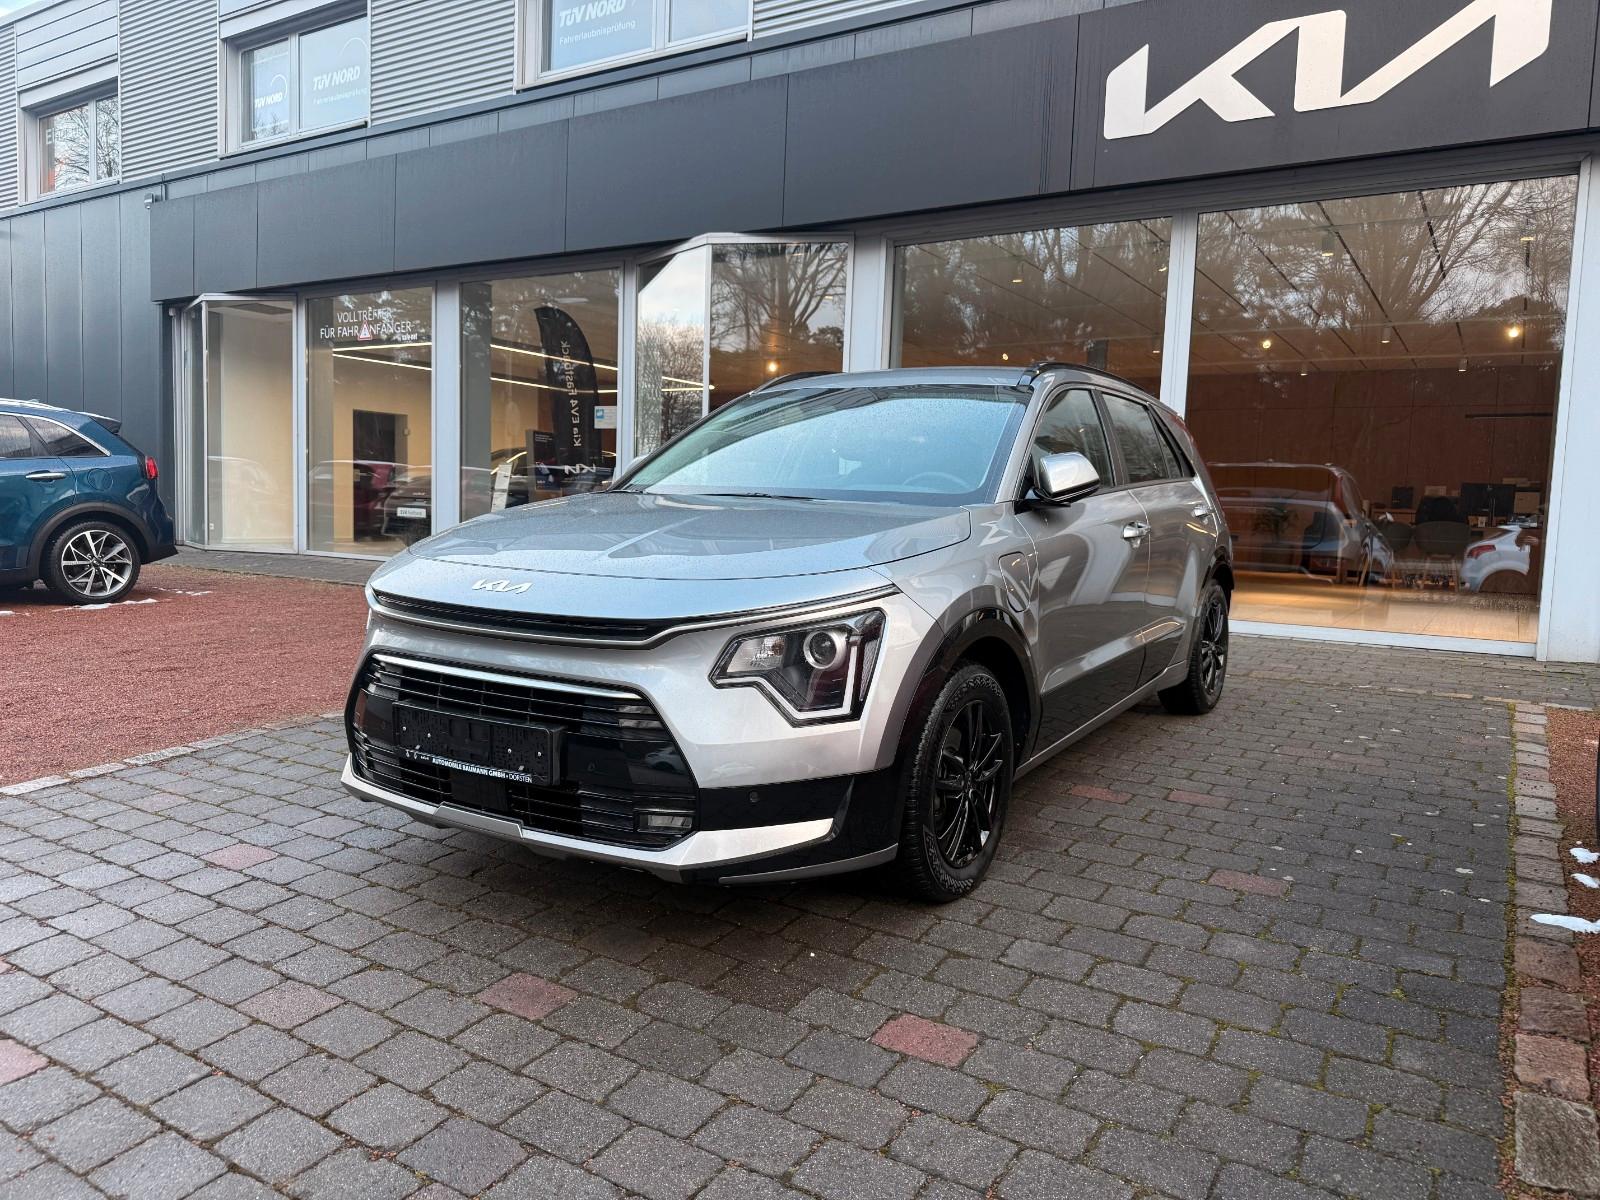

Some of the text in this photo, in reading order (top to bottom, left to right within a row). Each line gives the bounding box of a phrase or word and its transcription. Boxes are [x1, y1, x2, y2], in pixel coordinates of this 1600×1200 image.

[585, 0, 626, 21] NORD
[331, 65, 360, 87] NORD
[1104, 0, 1552, 140] KIA
[265, 92, 283, 105] NORD
[320, 324, 336, 339] FÜR
[471, 578, 533, 595] KIA
